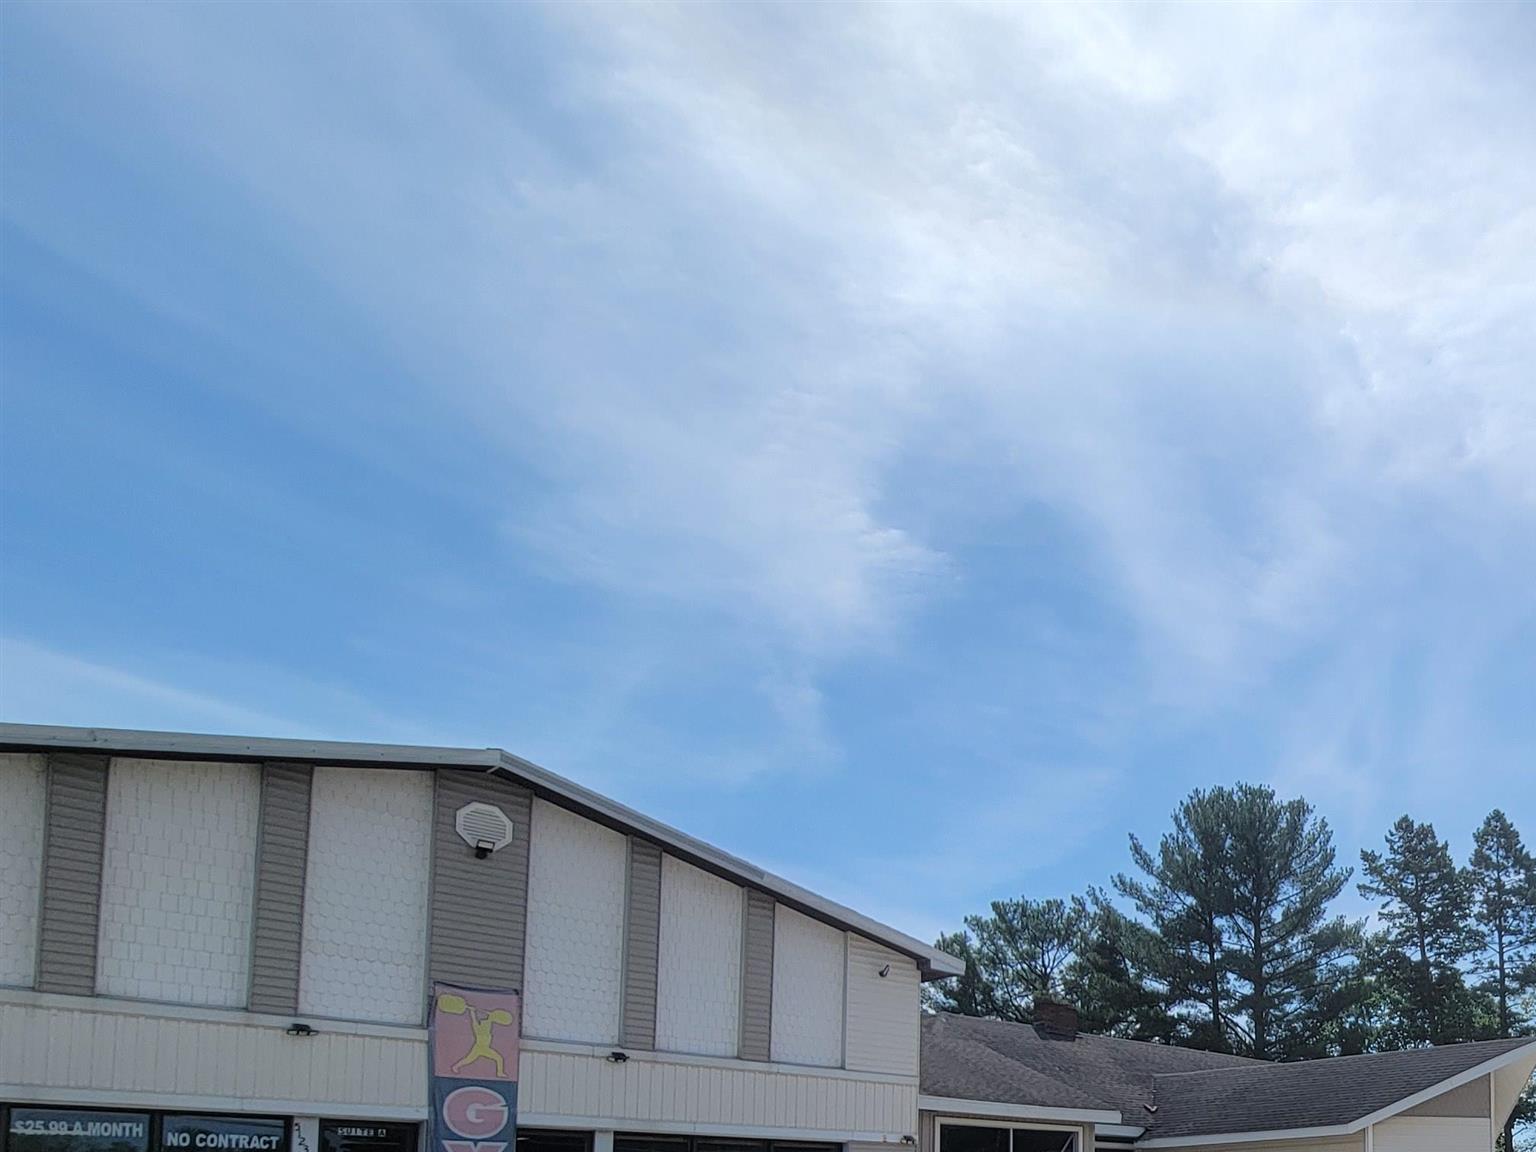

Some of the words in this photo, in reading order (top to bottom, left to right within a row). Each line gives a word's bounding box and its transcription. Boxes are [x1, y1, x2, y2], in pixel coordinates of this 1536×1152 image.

[87, 1122, 143, 1137] MONTH
[167, 1132, 191, 1147] NO
[196, 1133, 280, 1150] CONTRACT
